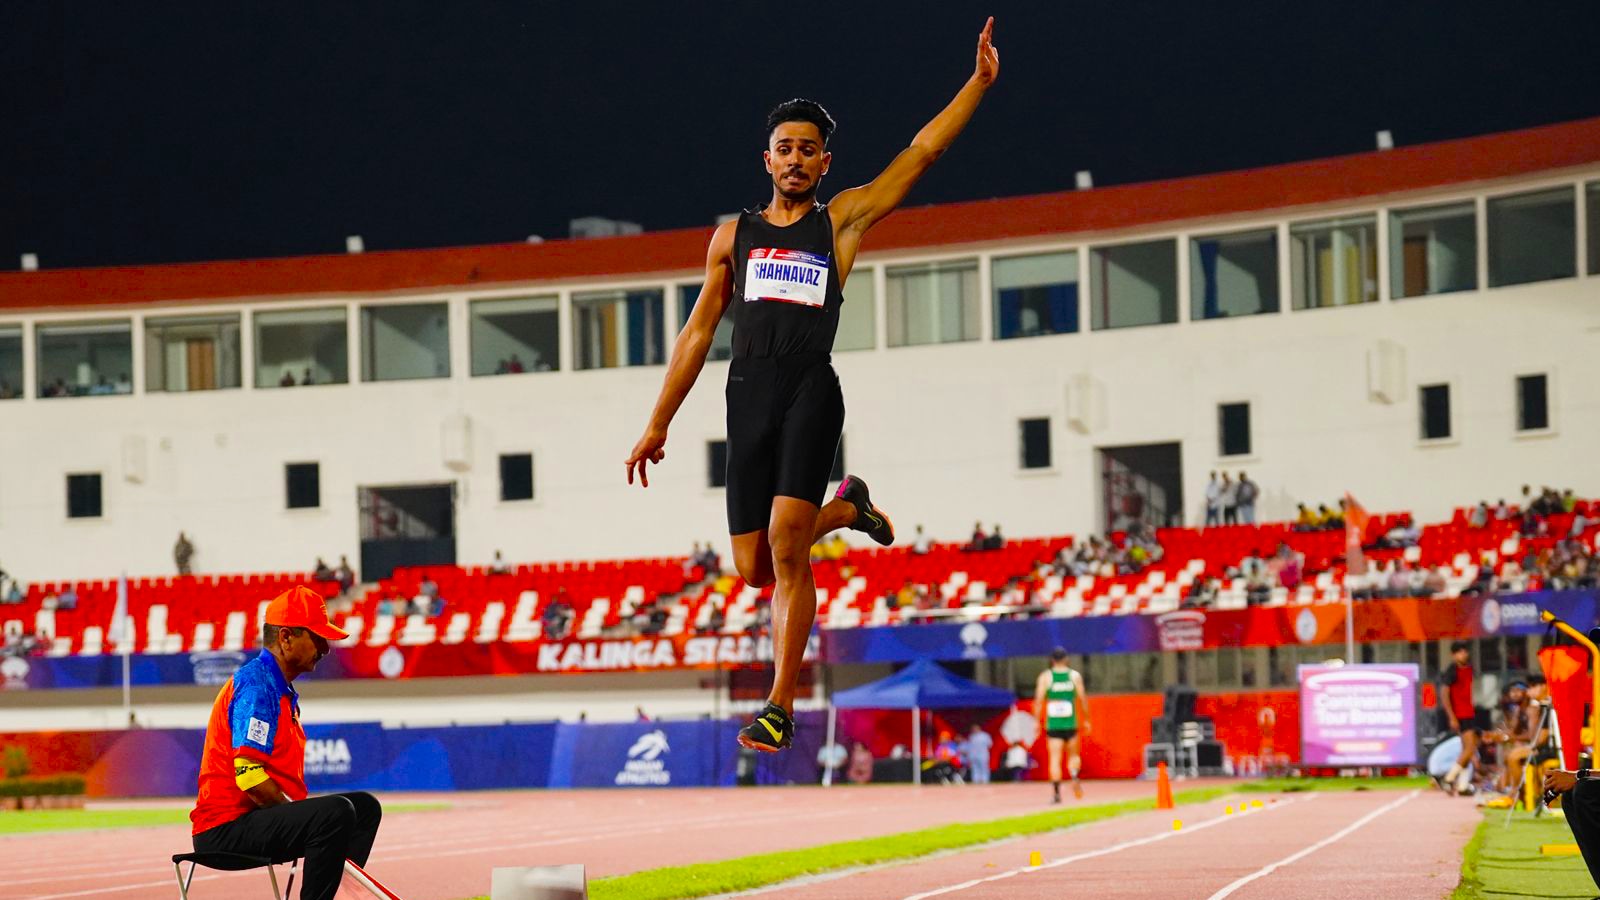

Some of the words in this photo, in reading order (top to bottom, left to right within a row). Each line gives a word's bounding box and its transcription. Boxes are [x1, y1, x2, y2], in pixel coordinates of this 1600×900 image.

[754, 263, 821, 286] SHAHNAVAZ
[539, 639, 675, 670] KALINGA
[766, 712, 785, 725] NIKE
